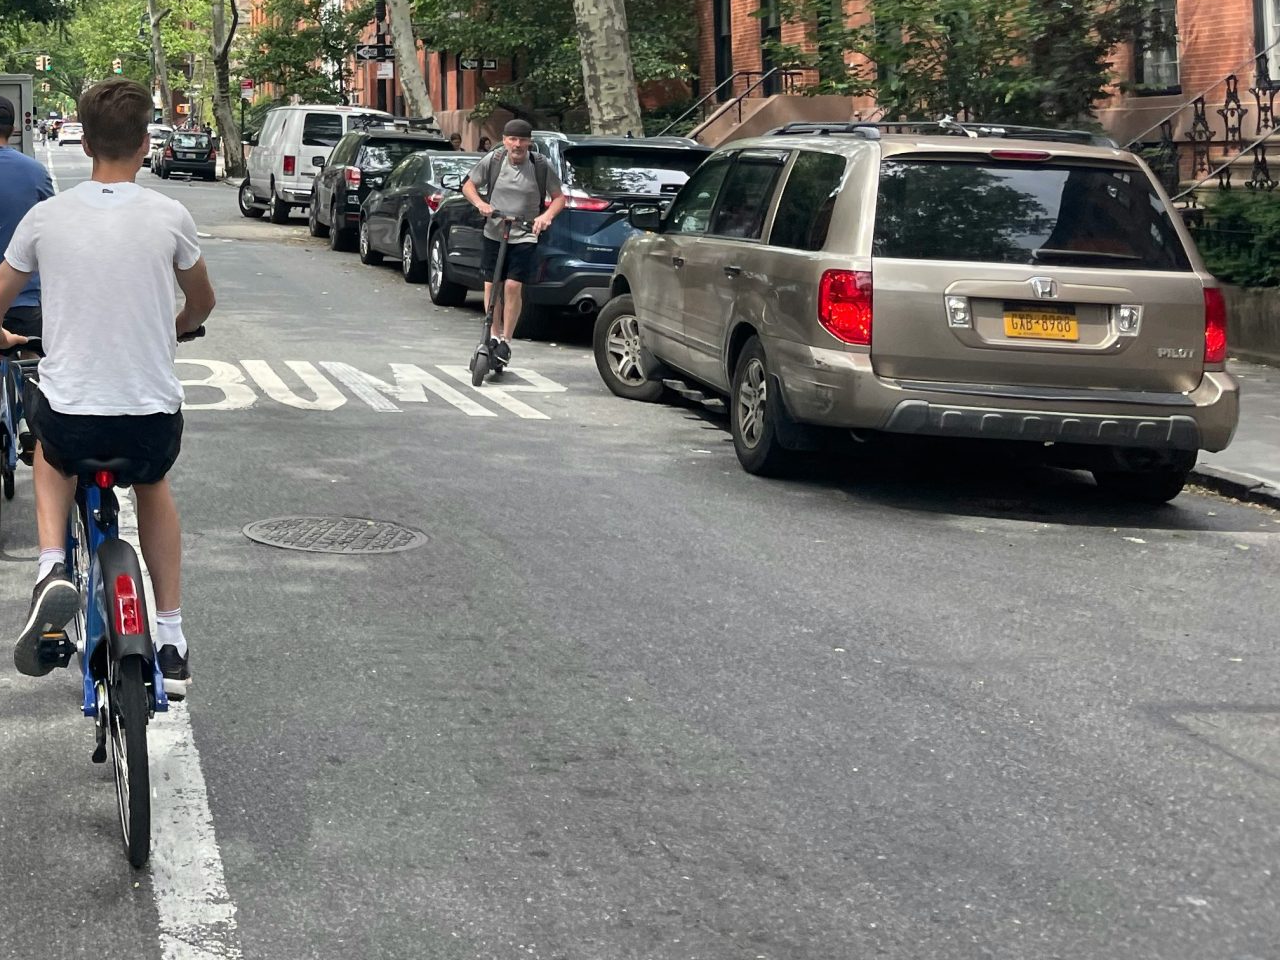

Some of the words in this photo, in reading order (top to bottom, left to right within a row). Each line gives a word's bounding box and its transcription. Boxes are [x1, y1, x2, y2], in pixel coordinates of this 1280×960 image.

[1011, 312, 1033, 331] GXB
[1157, 347, 1196, 359] PILOT
[173, 358, 568, 420] BUMP
